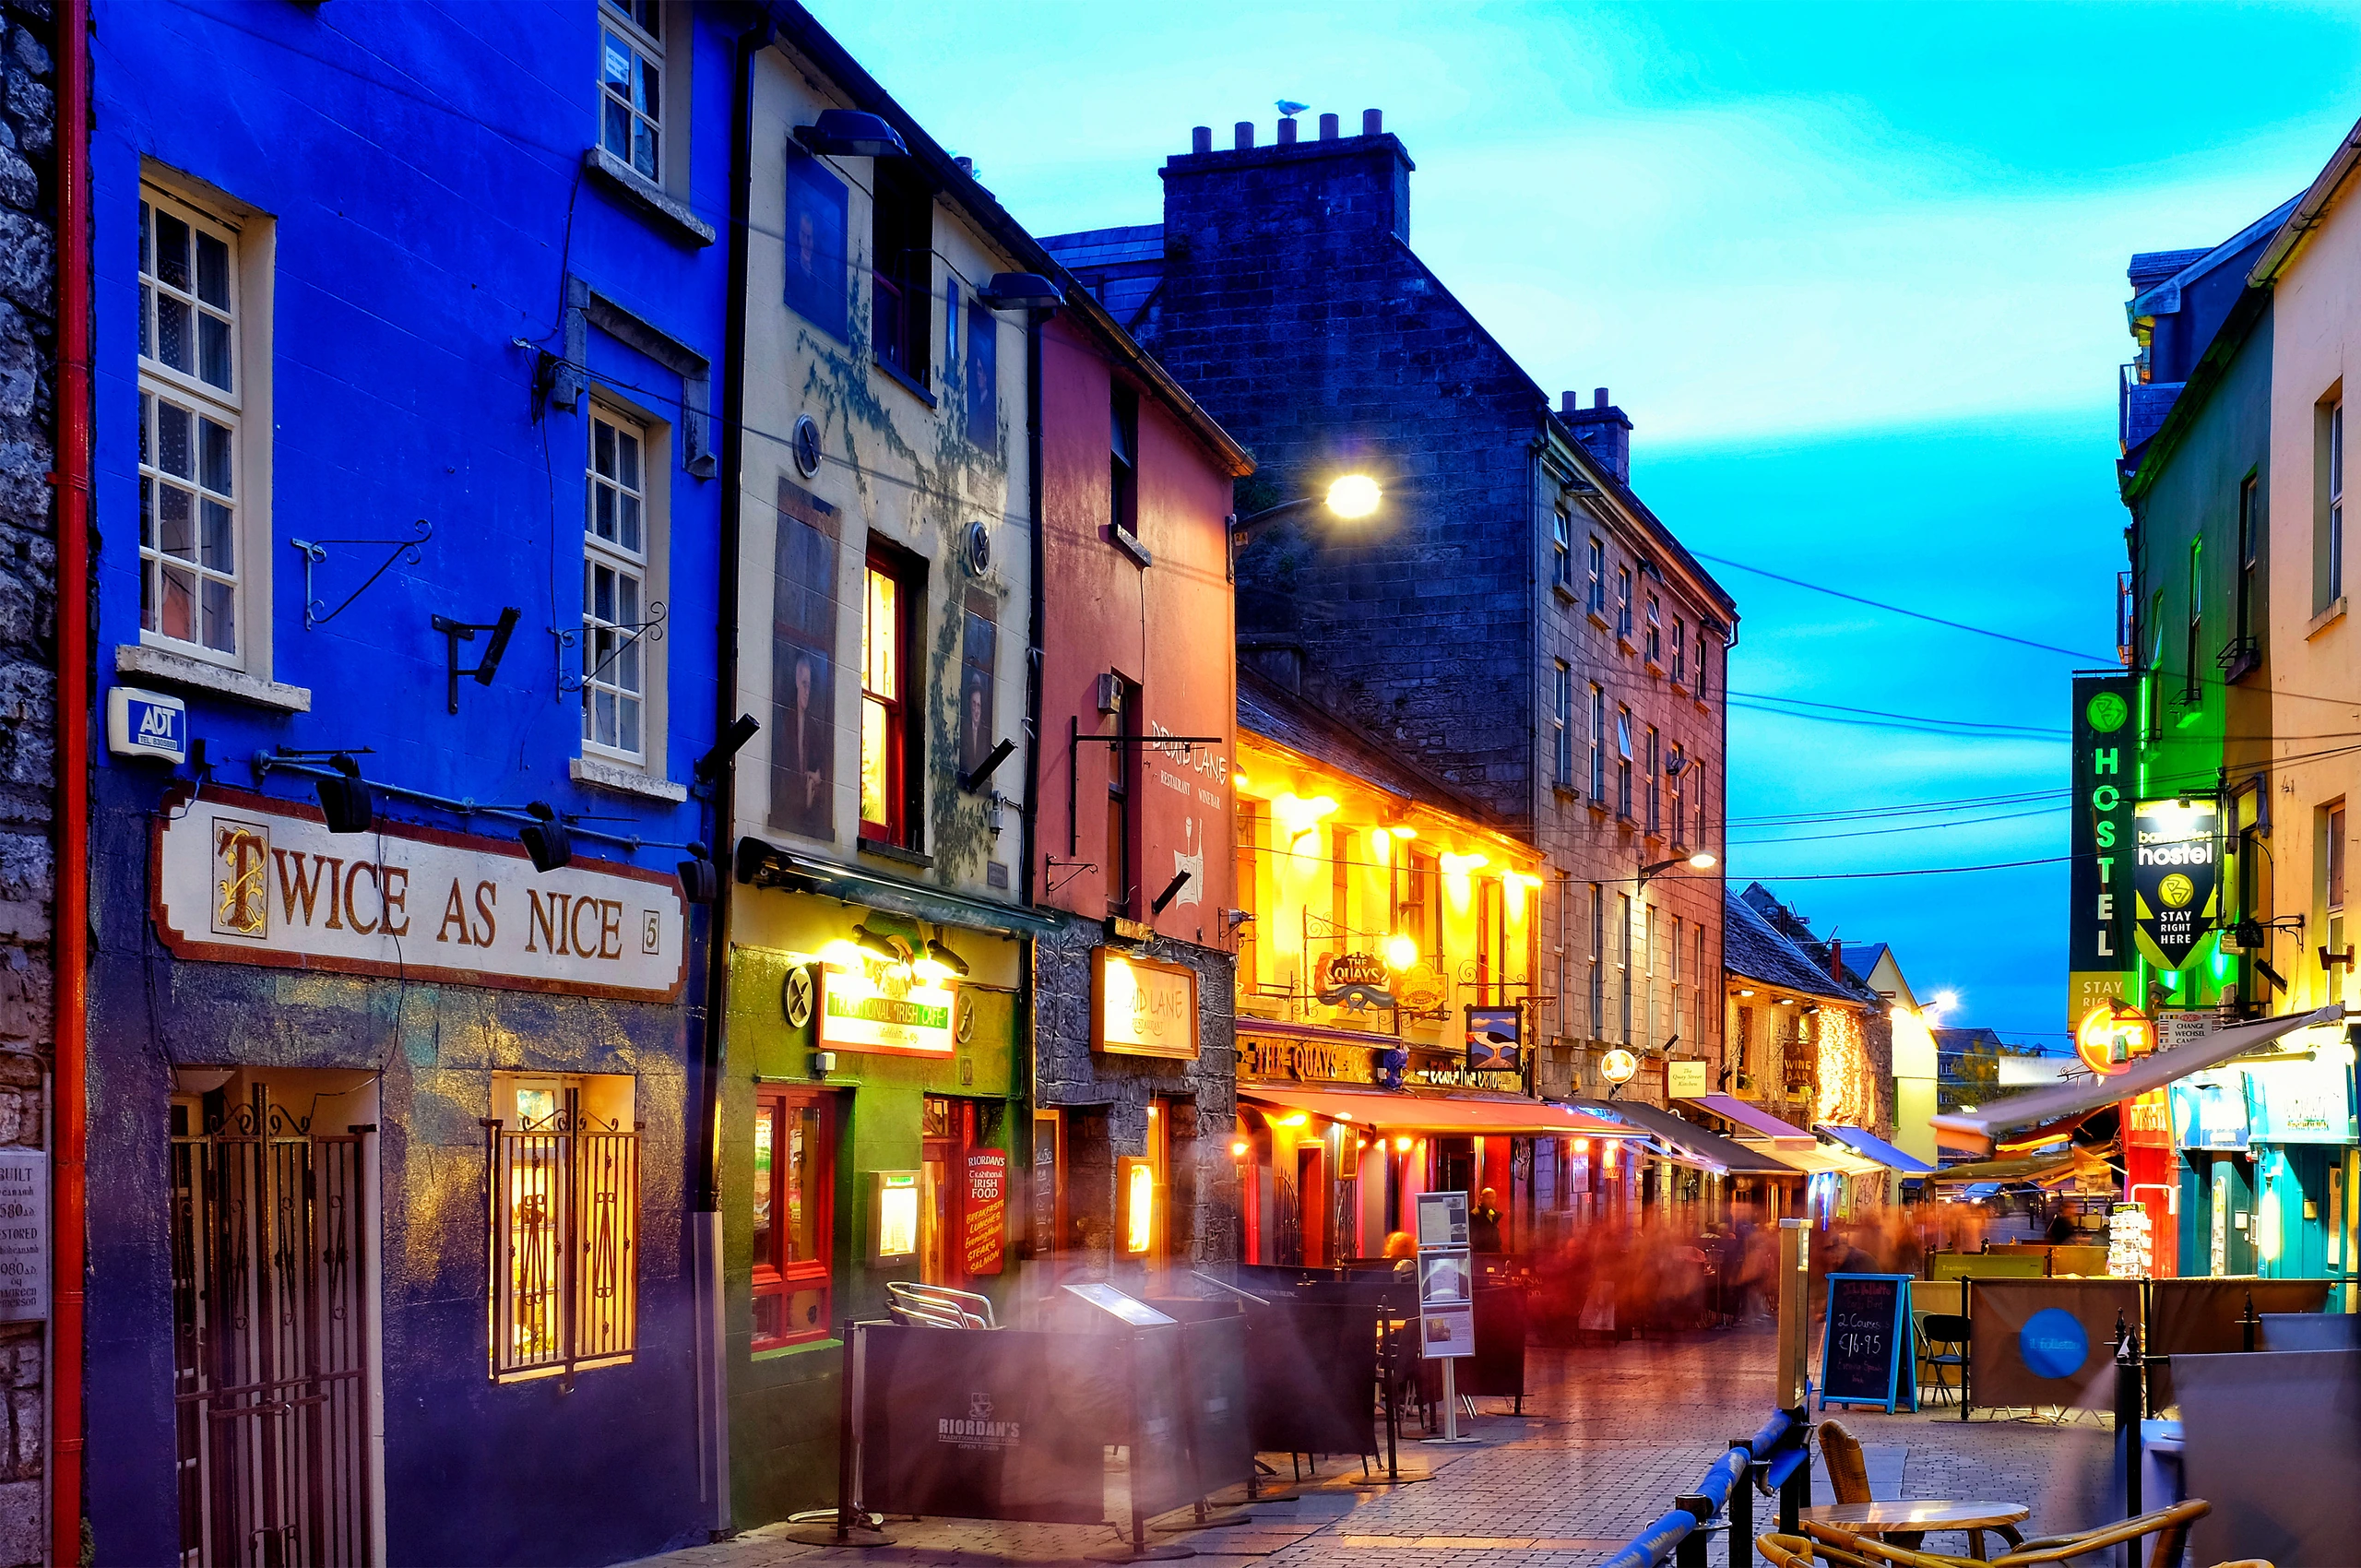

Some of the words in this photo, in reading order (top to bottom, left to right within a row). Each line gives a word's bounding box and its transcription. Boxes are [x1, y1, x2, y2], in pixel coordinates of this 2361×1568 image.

[140, 706, 176, 737] ADT
[1151, 719, 1191, 766] DRUID
[1193, 742, 1227, 786] LANE
[1160, 769, 1191, 796] RESTAURANT
[2093, 748, 2120, 956] HOSTEL
[2138, 842, 2213, 866] hostel
[218, 826, 411, 936] TWICE
[436, 877, 497, 948] AS
[525, 888, 623, 960] NICE
[646, 918, 657, 948] 5
[2160, 911, 2192, 922] STAY
[2160, 923, 2191, 932] RIGHT
[2160, 934, 2191, 944] HERE
[1347, 957, 1367, 968] THE
[1334, 967, 1381, 984] QUAYS
[1406, 981, 1436, 992] PUB
[2082, 981, 2123, 993] STAY
[1151, 989, 1183, 1019] LANE
[894, 1003, 919, 1024] IRISH
[1255, 1042, 1284, 1074] THE
[1293, 1042, 1338, 1083] QUAYS
[1785, 1059, 1811, 1070] WINE
[1786, 1070, 1809, 1082] BAR
[968, 1155, 1005, 1167] RIORDAN'S
[974, 1178, 998, 1188] IRISH
[971, 1188, 999, 1199] FOOD
[969, 1211, 1001, 1234] LUNCHES
[969, 1248, 1001, 1273] SALMON
[1838, 1313, 1848, 1327] 2
[1849, 1313, 1881, 1329] Courses
[1838, 1333, 1881, 1358] €16.95
[939, 1418, 1020, 1438] RIORDAN'S
[939, 1433, 982, 1443] TRADITIONAL
